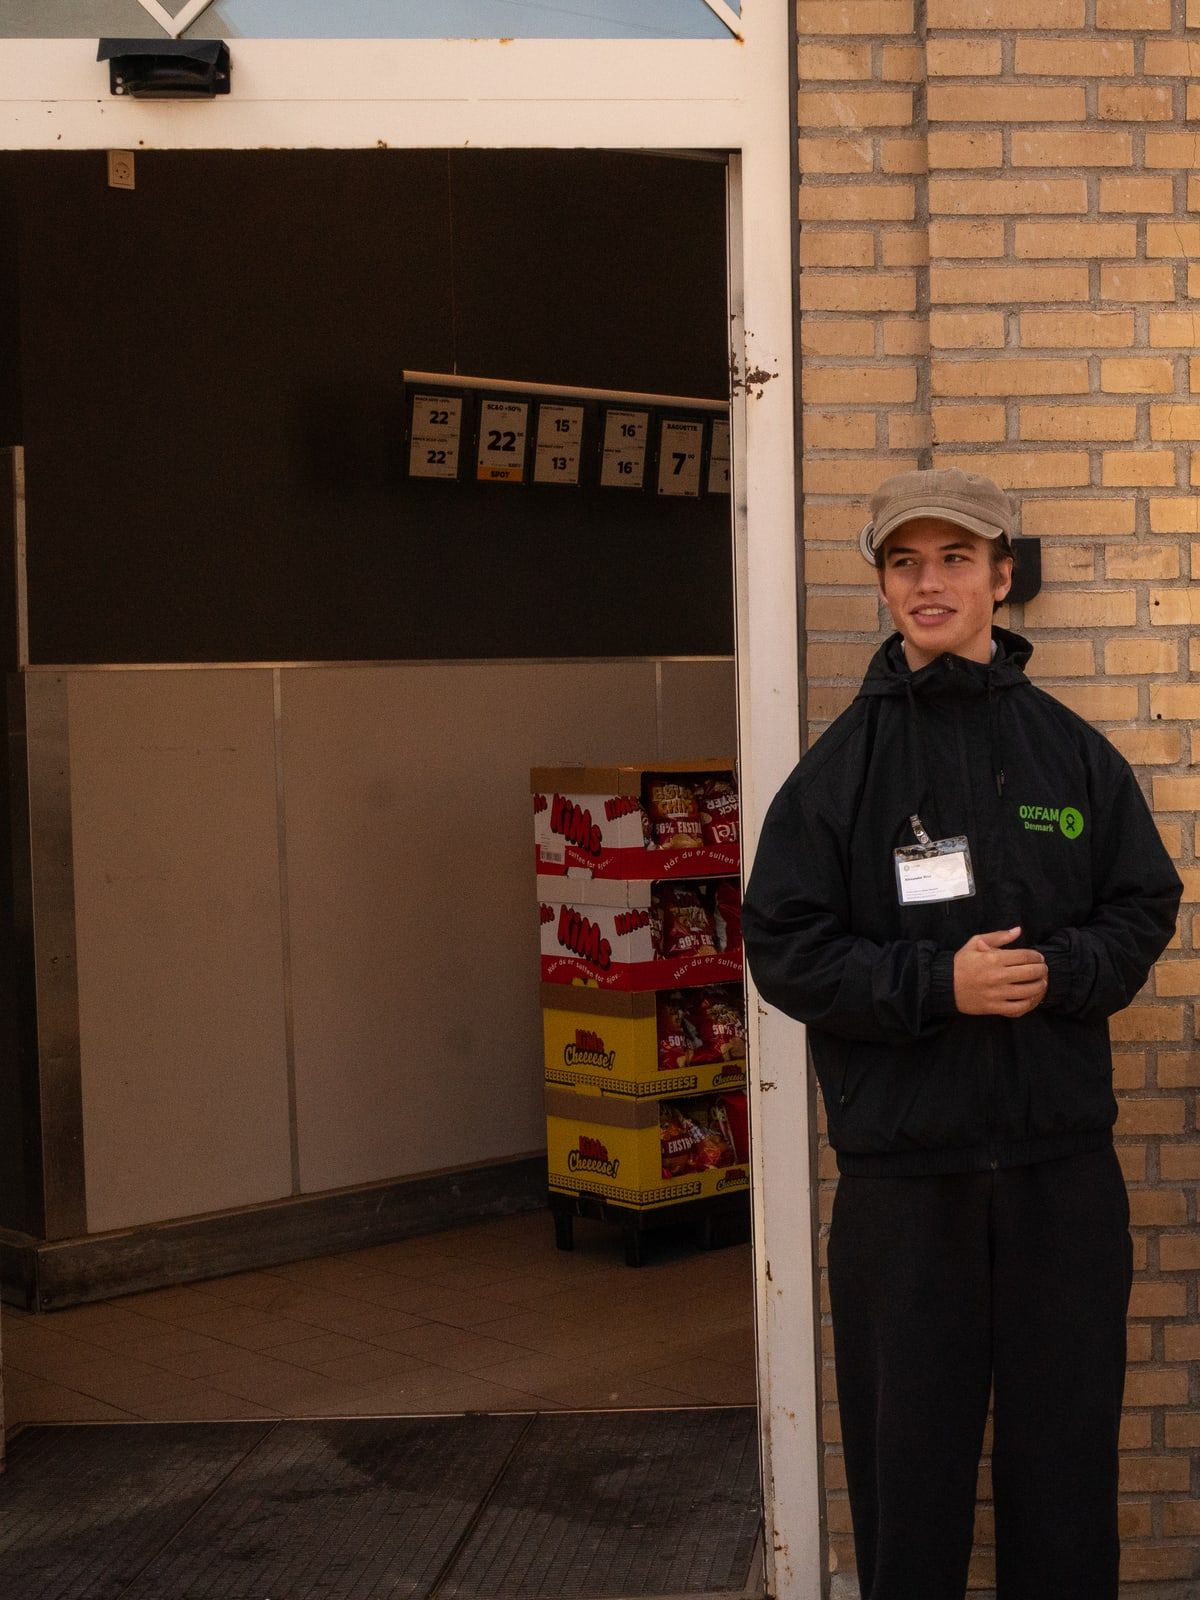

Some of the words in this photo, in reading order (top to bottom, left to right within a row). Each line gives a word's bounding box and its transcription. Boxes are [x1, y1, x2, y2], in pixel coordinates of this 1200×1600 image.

[429, 411, 449, 425] 22
[554, 419, 570, 433] 15
[621, 424, 636, 437] 16
[667, 424, 698, 432] BAGUETTE
[487, 431, 516, 451] 22
[427, 451, 447, 464] 22
[551, 457, 567, 470] 13
[672, 452, 687, 475] 7
[617, 462, 632, 474] 16
[1019, 805, 1059, 822] OXFAM
[1024, 821, 1054, 832] Denmark
[681, 851, 693, 860] du
[696, 849, 706, 857] er
[708, 850, 735, 865] sulten
[679, 935, 699, 948] 50%
[691, 958, 702, 967] du
[712, 1025, 732, 1036] 50%
